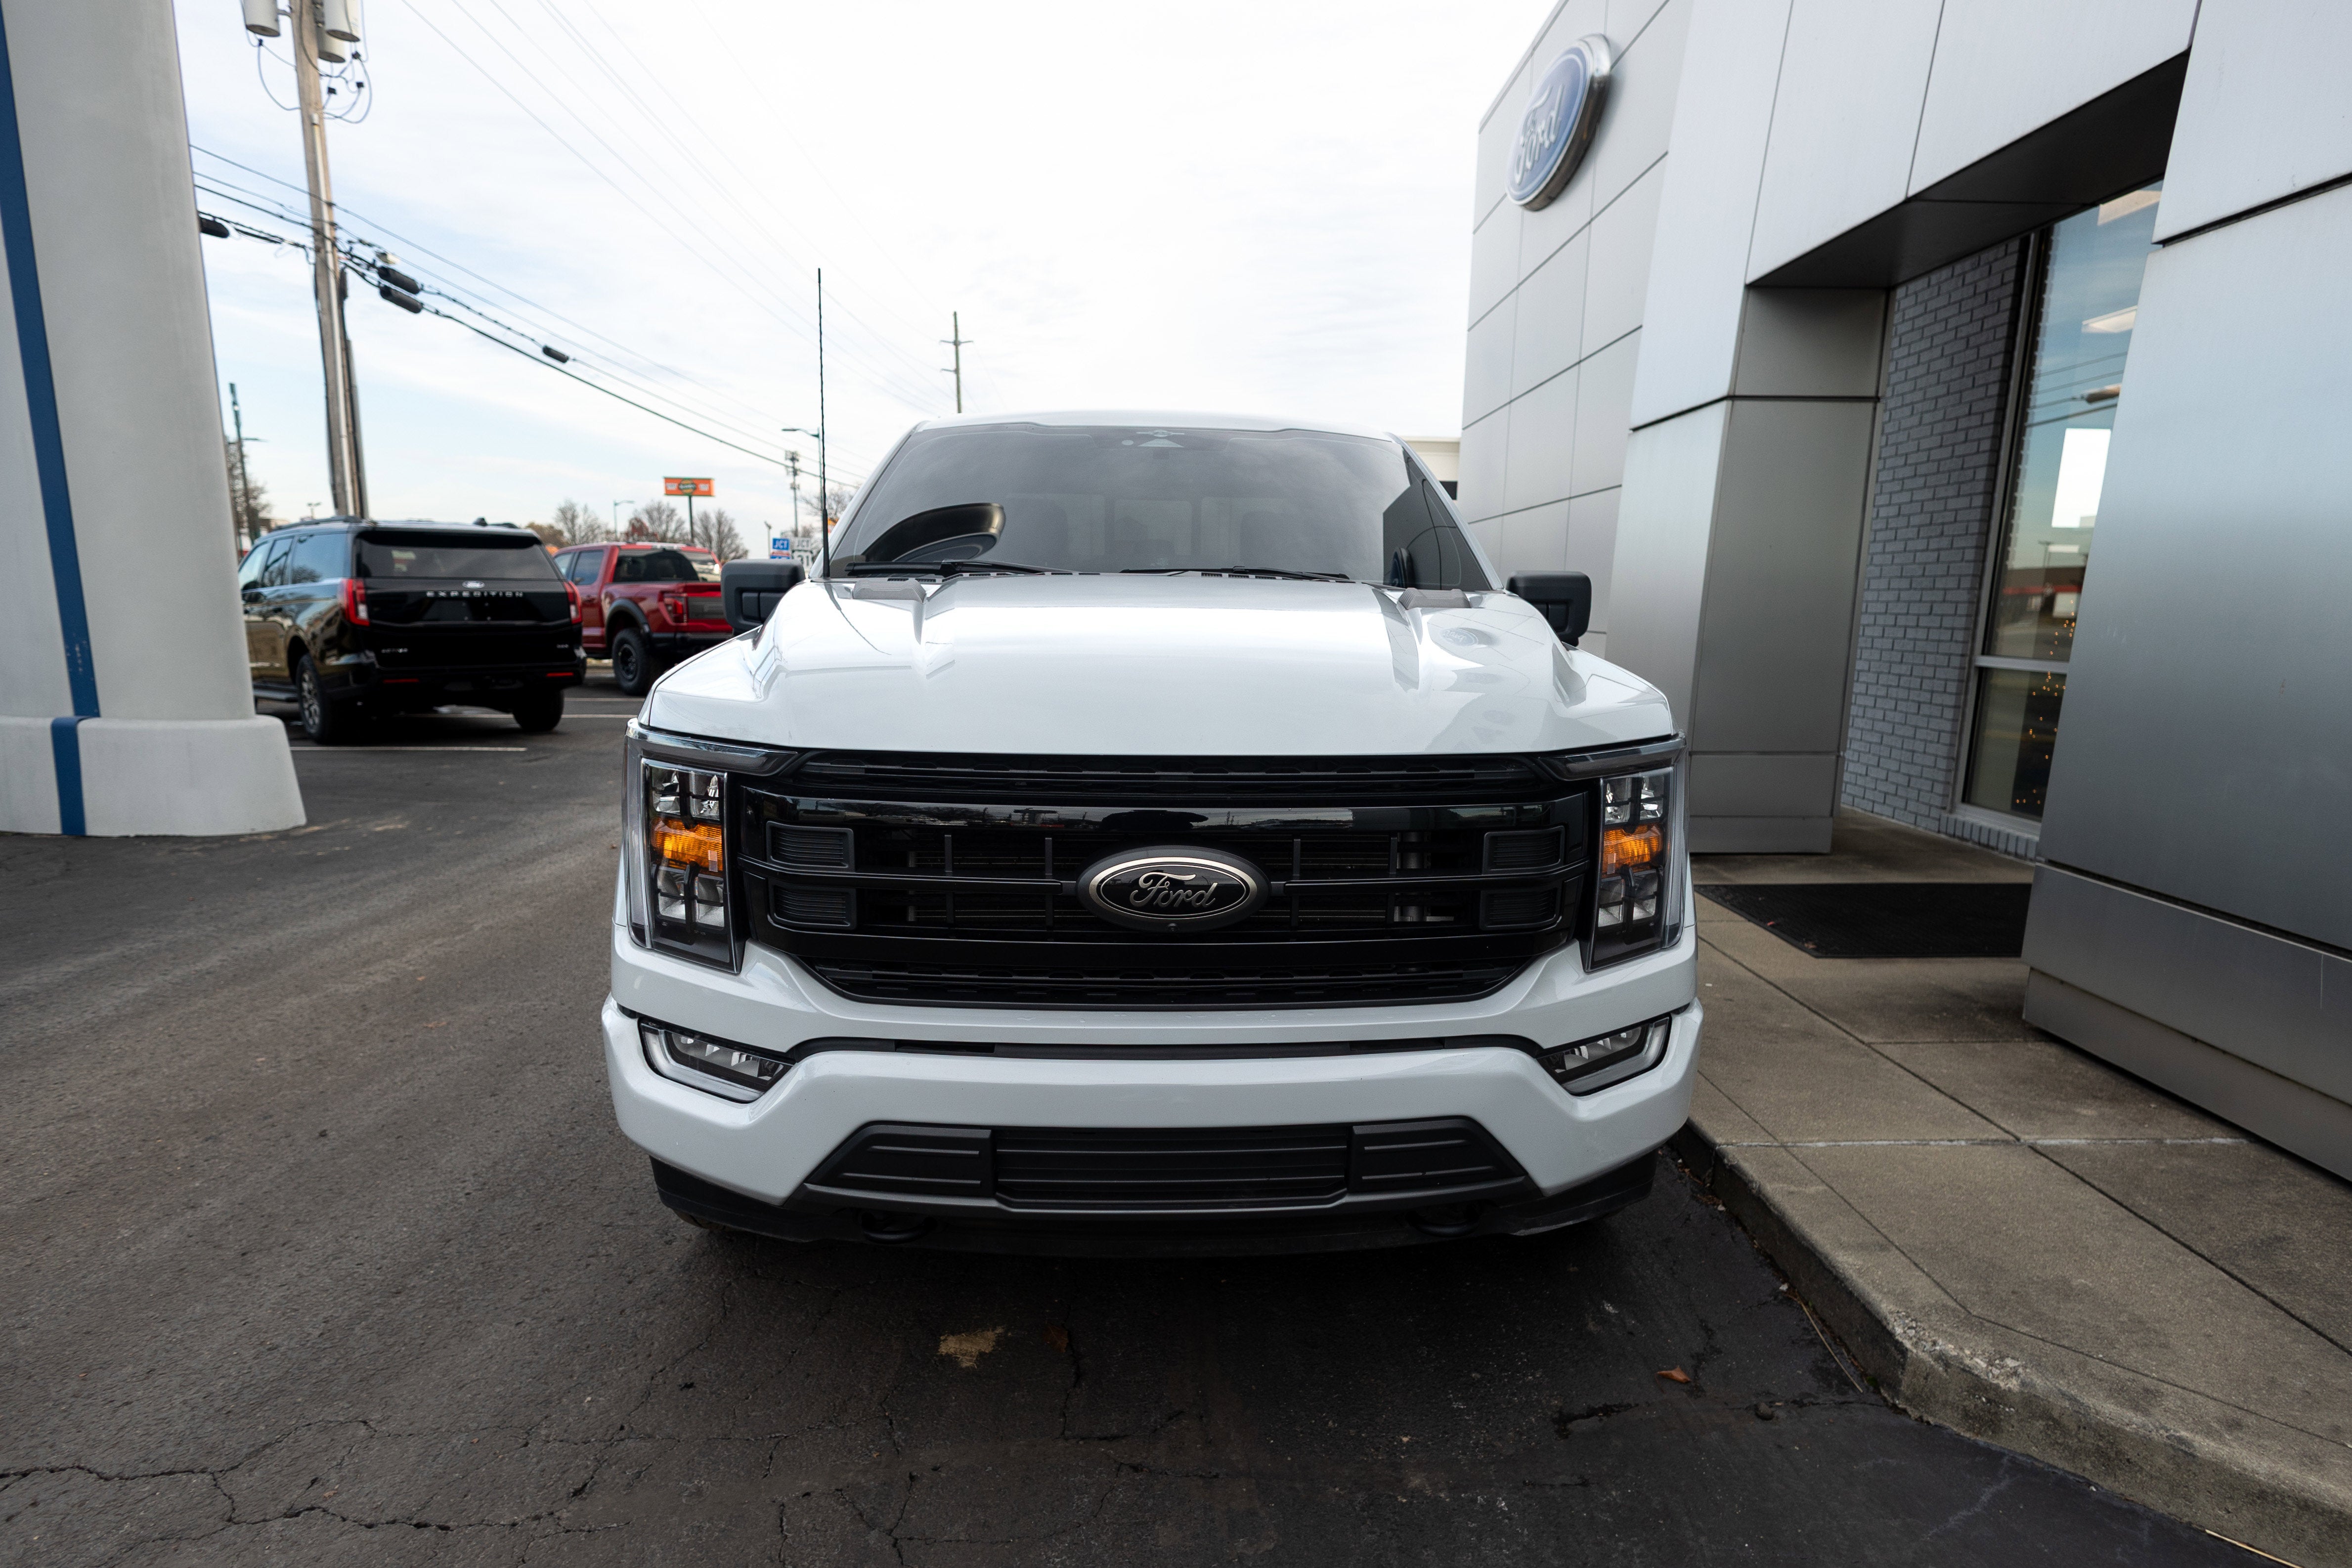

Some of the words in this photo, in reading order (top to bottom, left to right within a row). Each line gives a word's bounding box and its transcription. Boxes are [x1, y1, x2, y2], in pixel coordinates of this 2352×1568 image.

[1515, 84, 1565, 185] Ford
[774, 540, 787, 548] JCT
[1130, 872, 1218, 908] Ford
